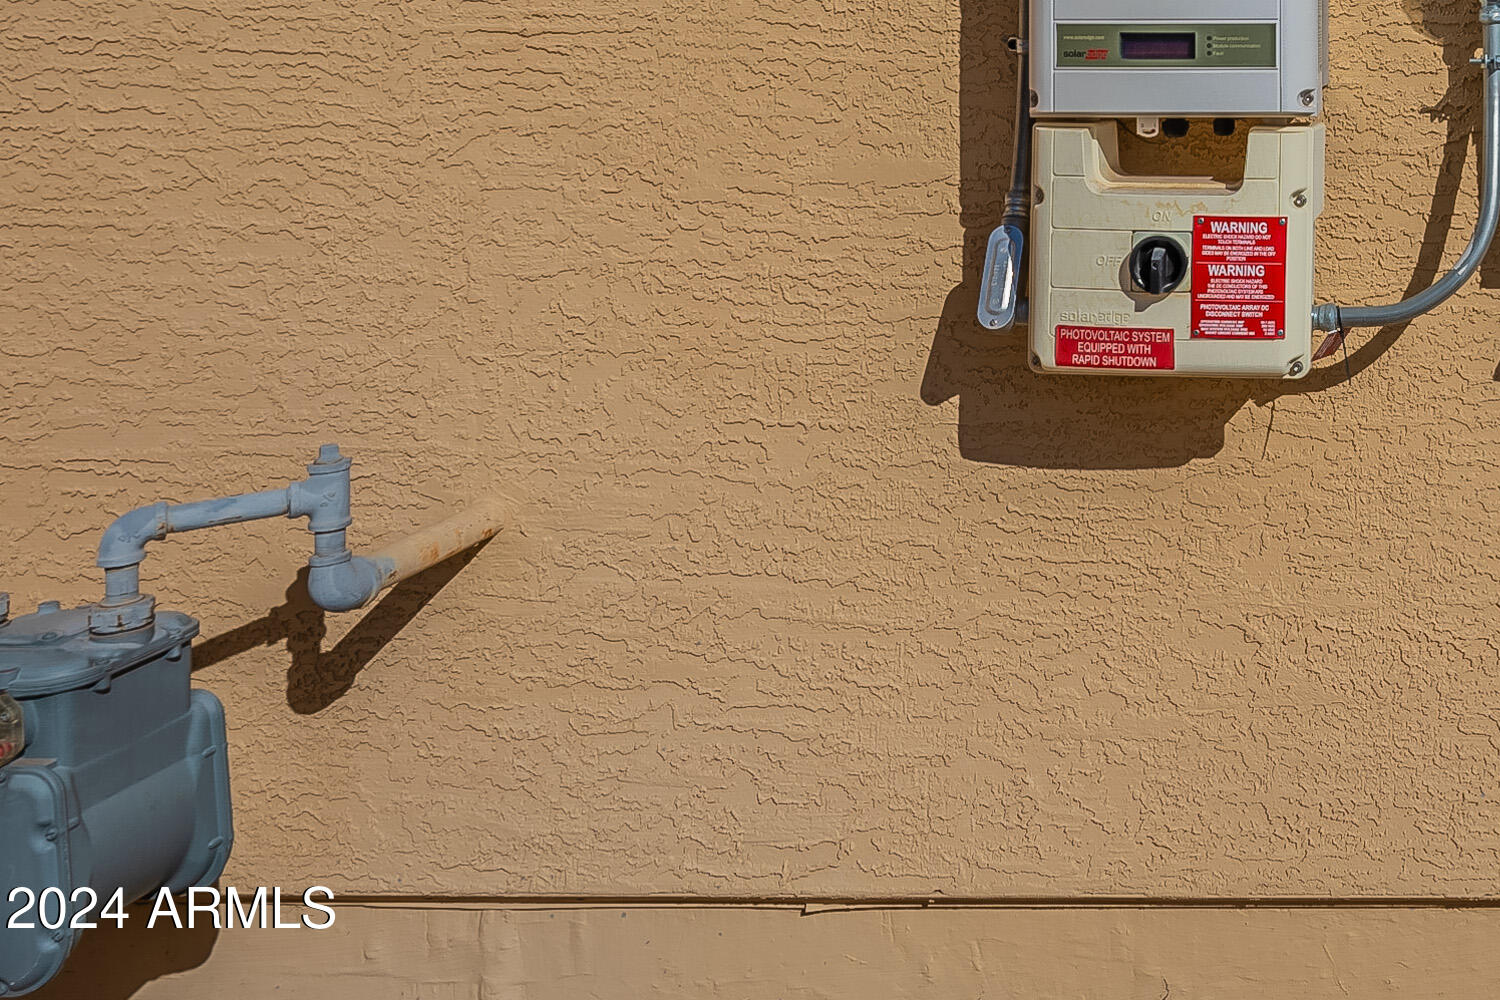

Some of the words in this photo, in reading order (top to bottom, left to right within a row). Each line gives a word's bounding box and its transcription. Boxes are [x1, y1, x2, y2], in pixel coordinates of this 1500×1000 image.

[1152, 211, 1172, 222] ON
[1210, 221, 1268, 234] WARNING
[1096, 256, 1122, 268] OFF
[1208, 264, 1266, 276] WARNING
[1060, 328, 1130, 342] PHOTOVOLTAIC
[1131, 331, 1171, 342] SYSTEM
[1078, 342, 1125, 354] EQUIPPED
[1126, 344, 1152, 354] WITH
[1072, 354, 1100, 366] RAPID
[1101, 356, 1157, 367] SHUTDOWN
